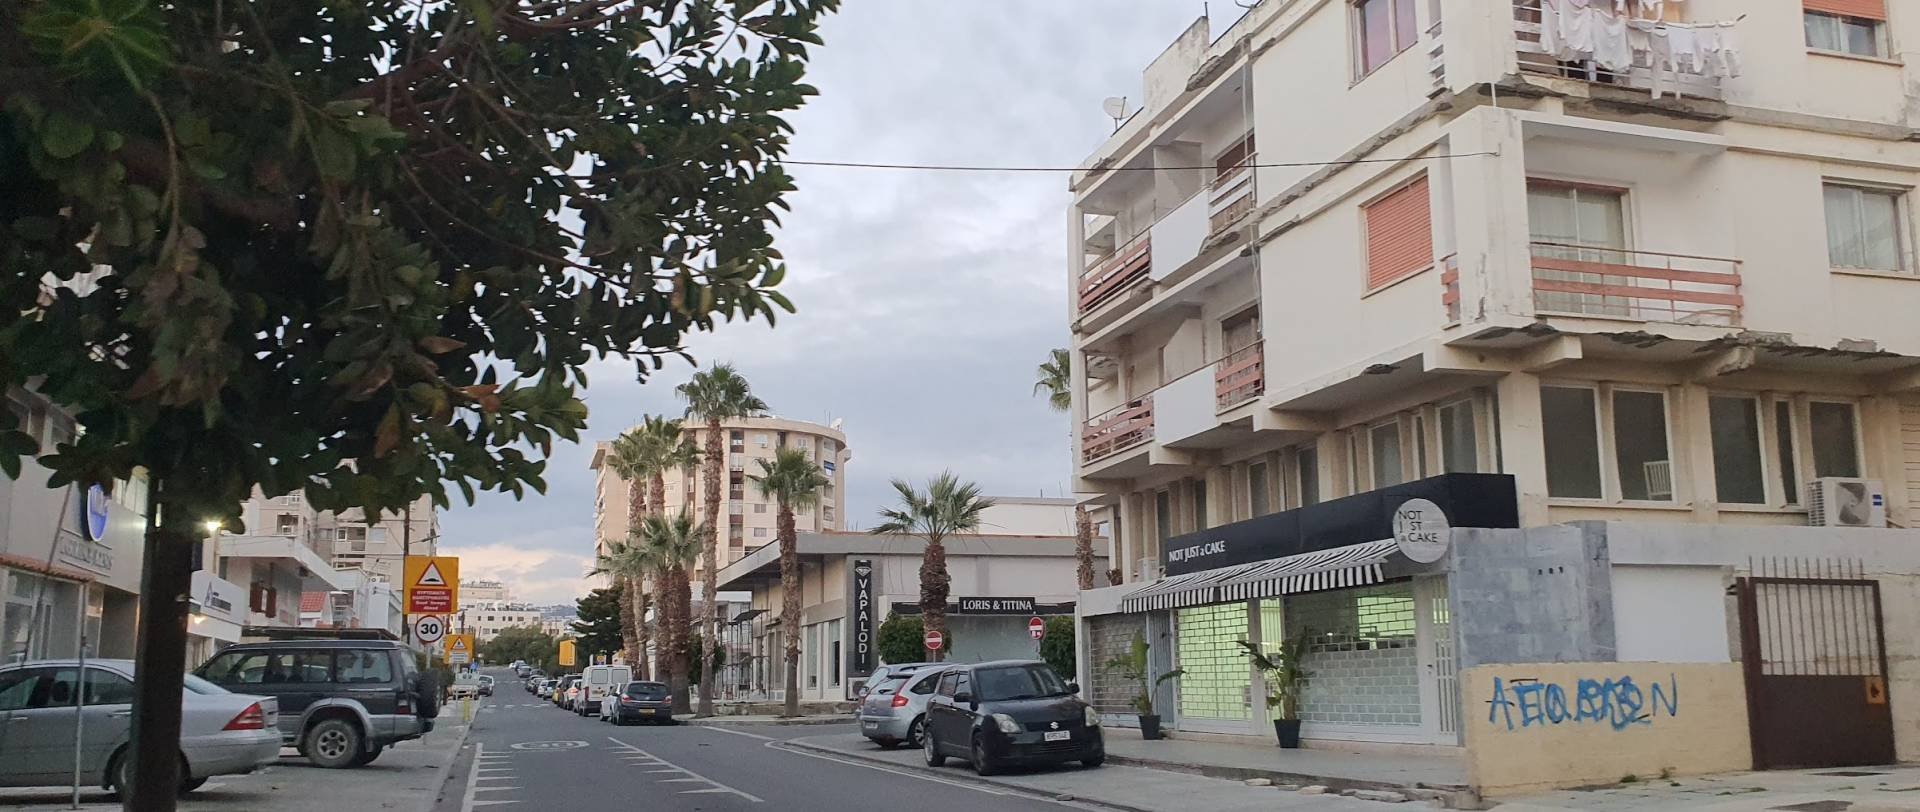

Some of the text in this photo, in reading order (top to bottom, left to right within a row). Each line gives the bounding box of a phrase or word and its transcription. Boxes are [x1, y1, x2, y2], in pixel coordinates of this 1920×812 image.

[1399, 510, 1423, 520] NOT
[1408, 532, 1438, 543] CAKE
[1169, 549, 1185, 562] NOT
[1184, 545, 1201, 562] JUST
[1205, 540, 1226, 555] CAKE
[963, 600, 1032, 610] LORIS & TITINA
[858, 579, 868, 664] VAPALODI
[420, 624, 438, 635] 30
